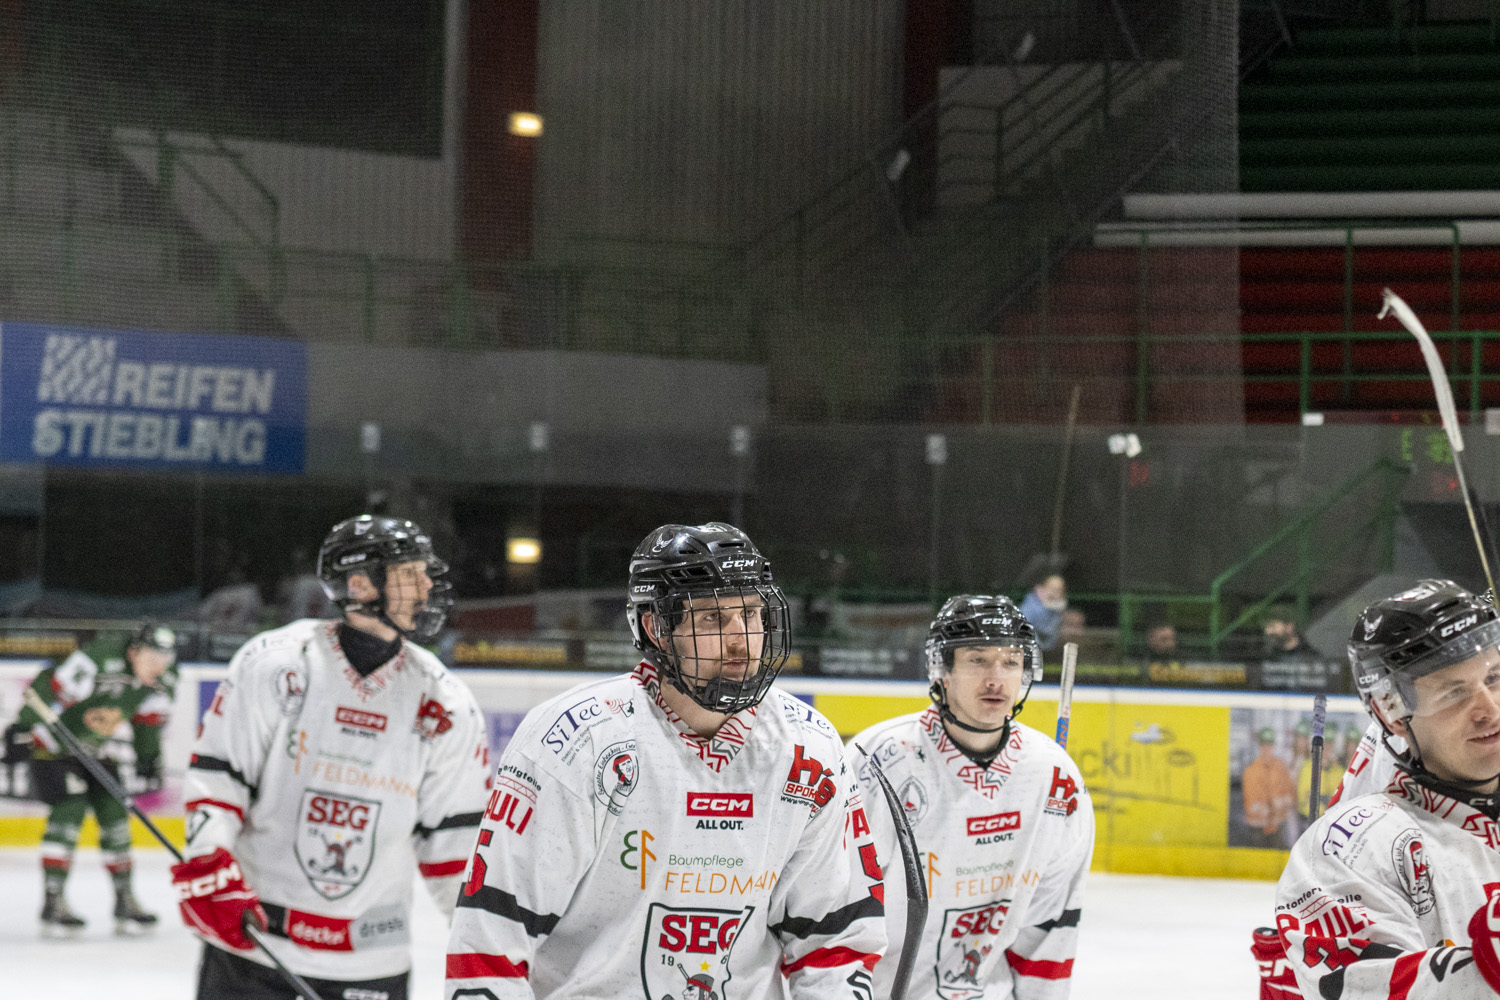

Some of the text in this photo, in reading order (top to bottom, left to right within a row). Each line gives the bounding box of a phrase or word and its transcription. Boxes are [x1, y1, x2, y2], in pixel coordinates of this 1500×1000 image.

[112, 362, 277, 414] REIFEN
[722, 559, 755, 569] CCM
[633, 584, 656, 594] CCM
[981, 616, 1013, 626] CCM
[1441, 614, 1479, 638] CCM
[1358, 673, 1380, 685] CCM
[545, 702, 602, 755] SiTec
[312, 760, 417, 798] FELDMANN
[694, 797, 751, 813] CCM
[307, 796, 371, 832] SEG
[696, 819, 744, 831] ALL OUT.
[969, 816, 1019, 832] CCM
[1328, 807, 1374, 857] iTec
[975, 832, 1014, 846] ALL OUT.
[668, 854, 744, 869] Baumpflege
[956, 860, 1014, 877] Baumpflege
[659, 913, 742, 955] SEG
[660, 953, 675, 967] 19
